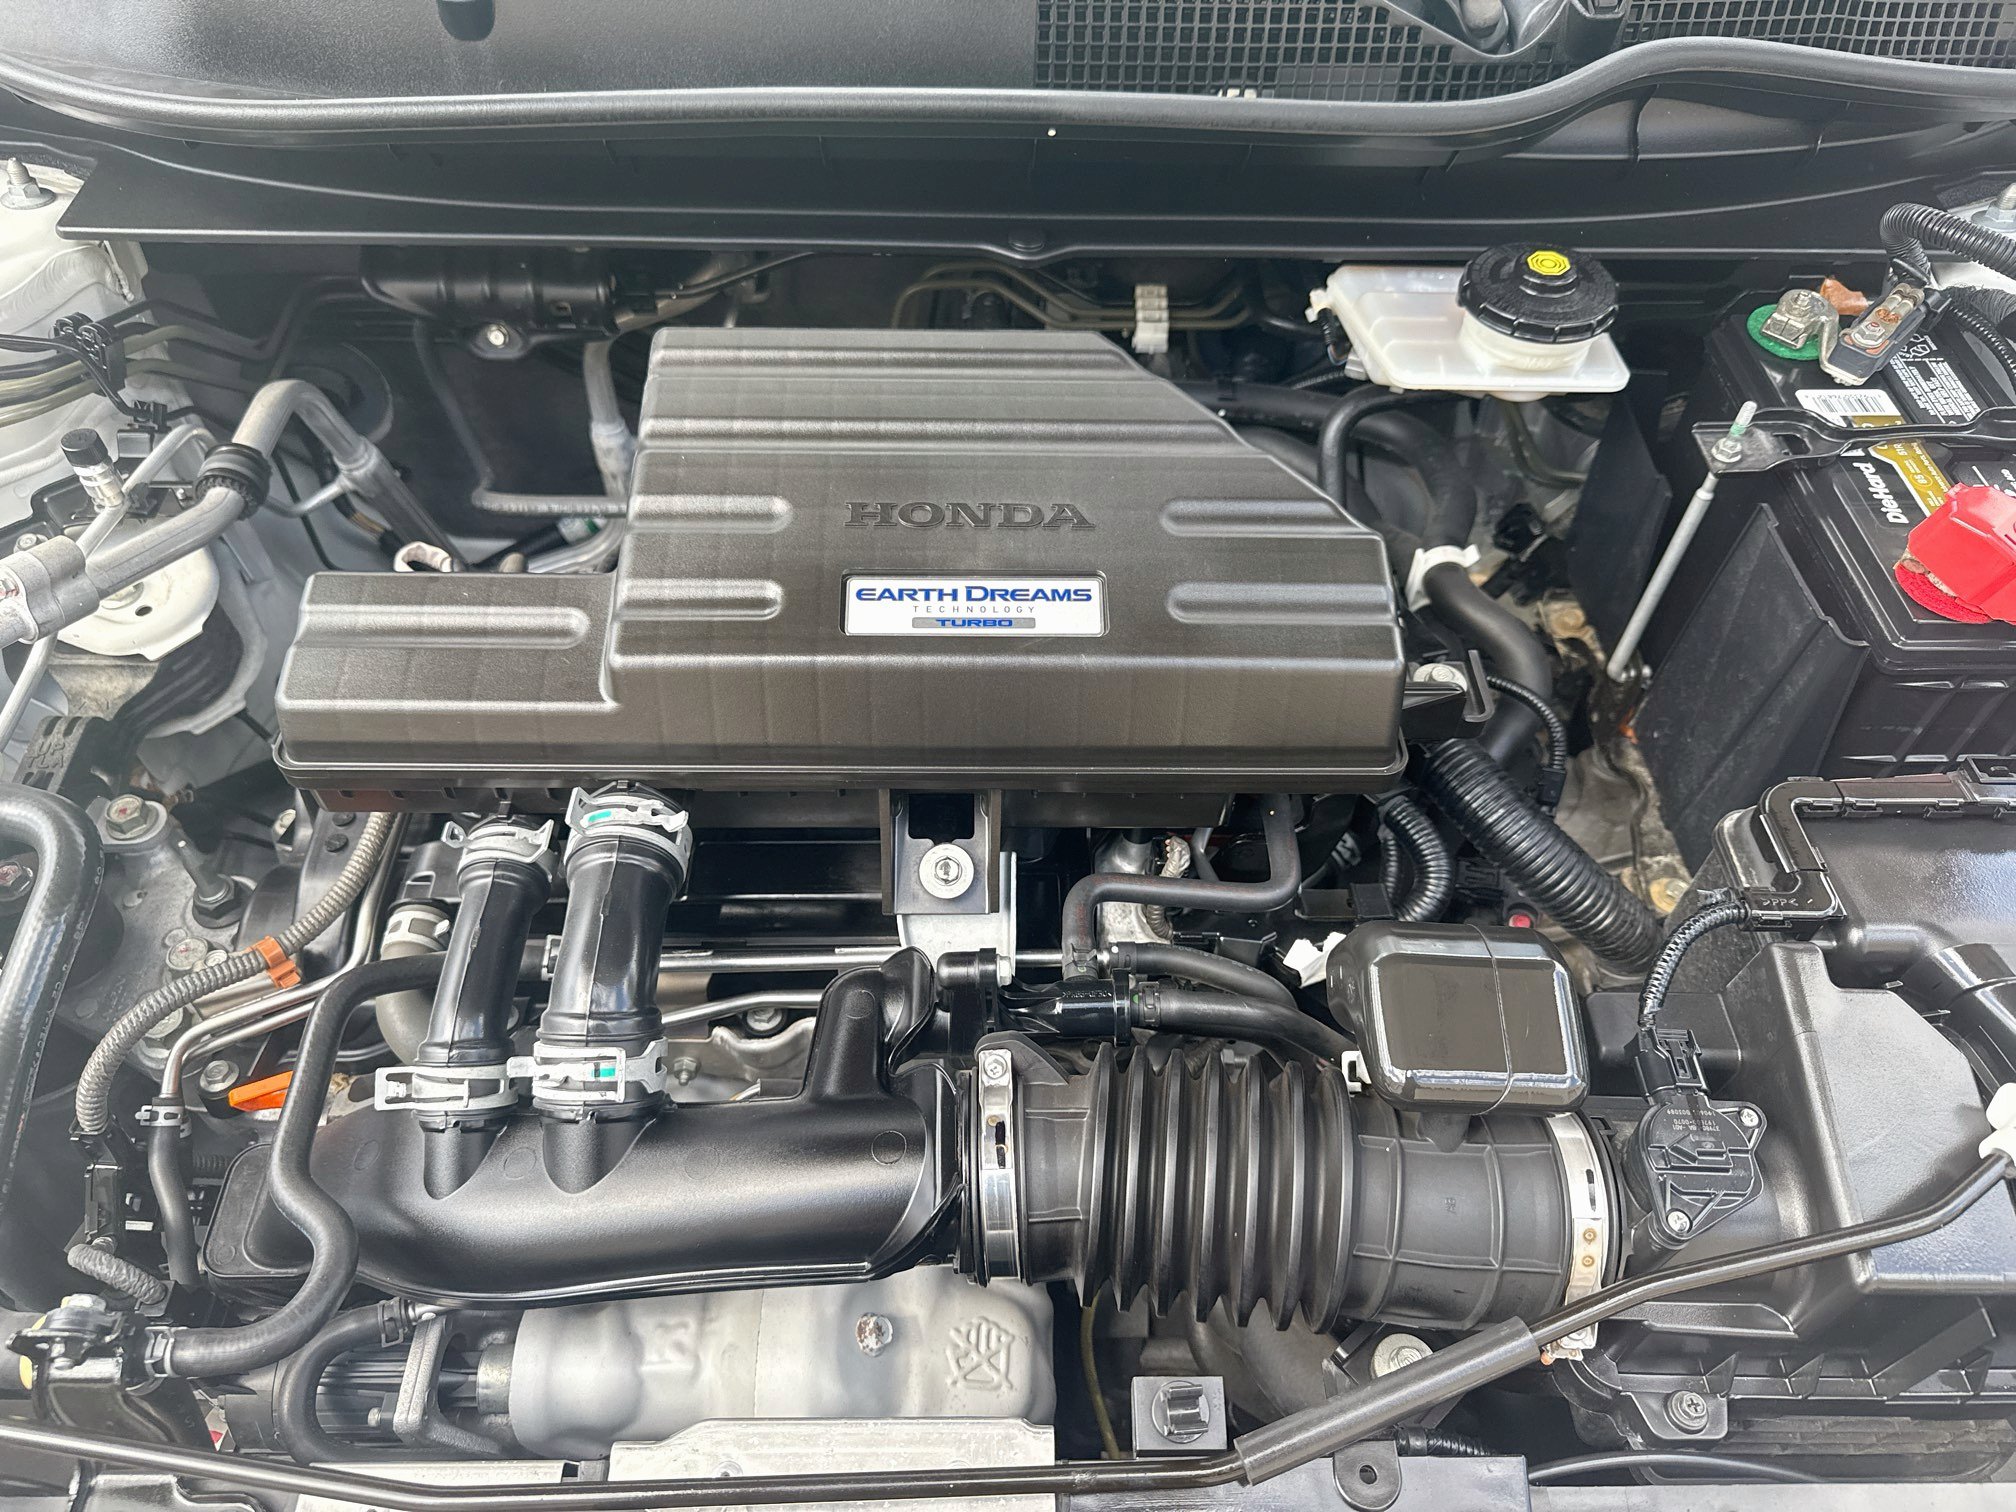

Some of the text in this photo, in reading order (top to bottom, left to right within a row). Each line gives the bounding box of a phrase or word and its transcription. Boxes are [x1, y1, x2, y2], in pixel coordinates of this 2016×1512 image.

[1852, 462, 1909, 524] DieHard
[844, 501, 1097, 529] HONDA
[856, 585, 1093, 602] EARTH DREAMS
[913, 605, 1036, 614] TECHNOLOGY
[935, 618, 1014, 628] TURBO
